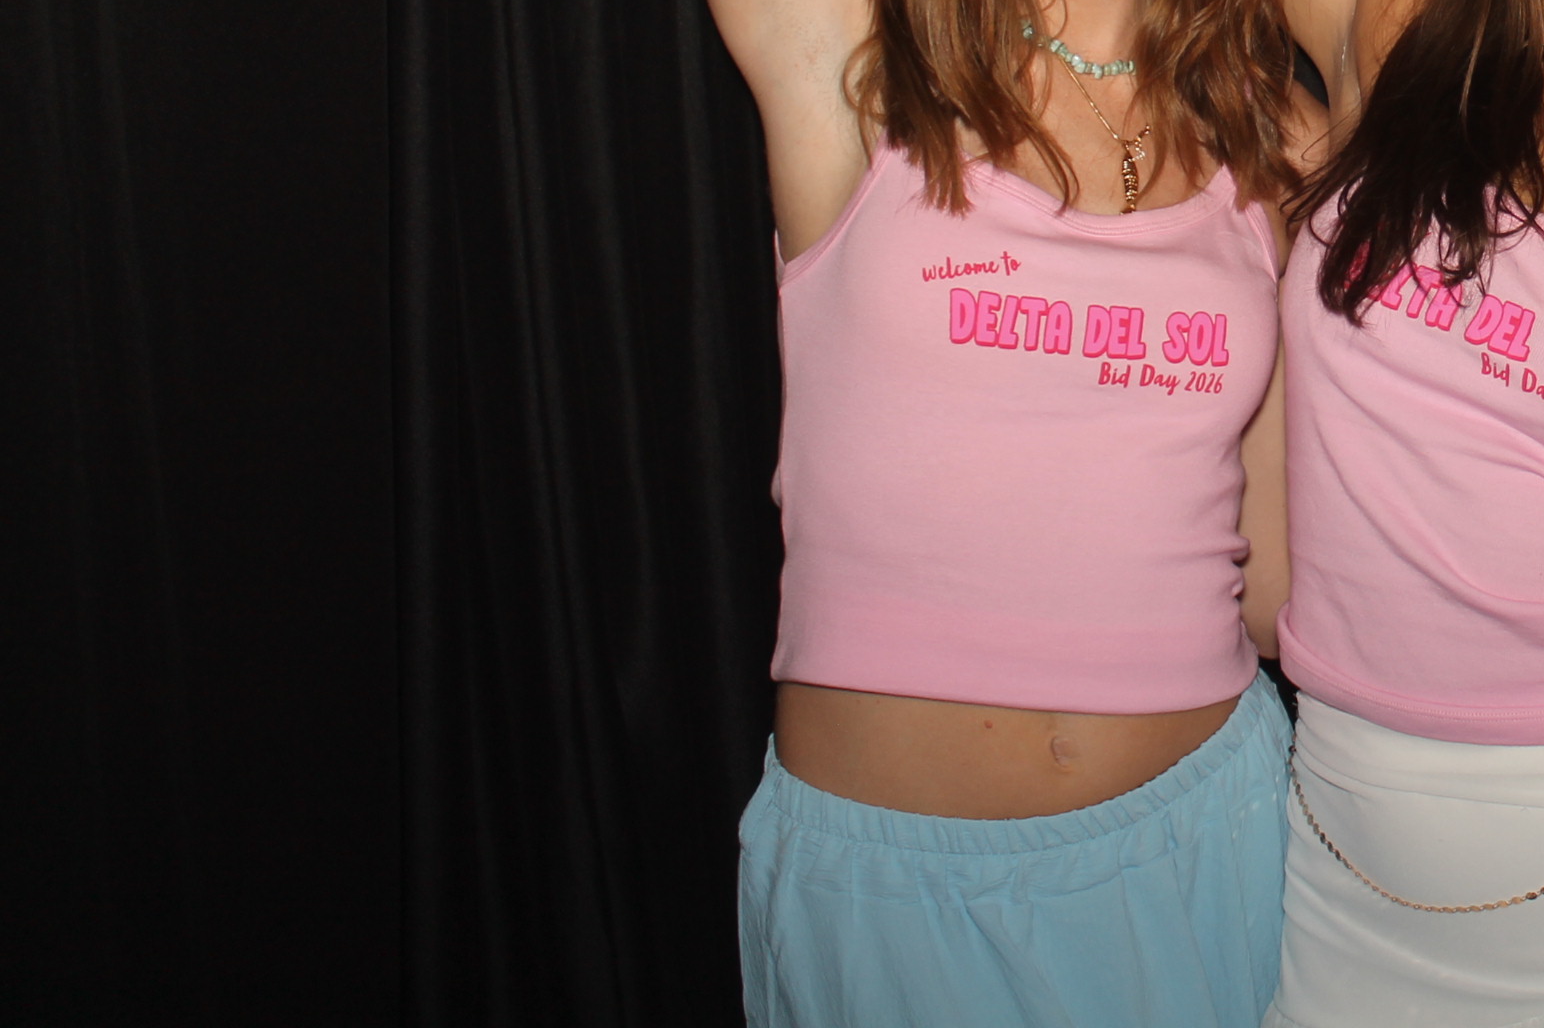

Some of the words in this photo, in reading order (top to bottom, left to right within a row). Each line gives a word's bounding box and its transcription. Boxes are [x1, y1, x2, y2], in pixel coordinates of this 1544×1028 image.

[922, 257, 999, 282] welcome
[1000, 251, 1021, 276] to
[950, 287, 1072, 355] DELTA
[1082, 304, 1146, 360] DEL
[1162, 311, 1229, 367] SOL
[1464, 294, 1536, 362] DEL
[1098, 361, 1131, 389] Bid
[1139, 364, 1181, 396] Day
[1184, 371, 1224, 395] 2026
[1480, 352, 1510, 387] Bid
